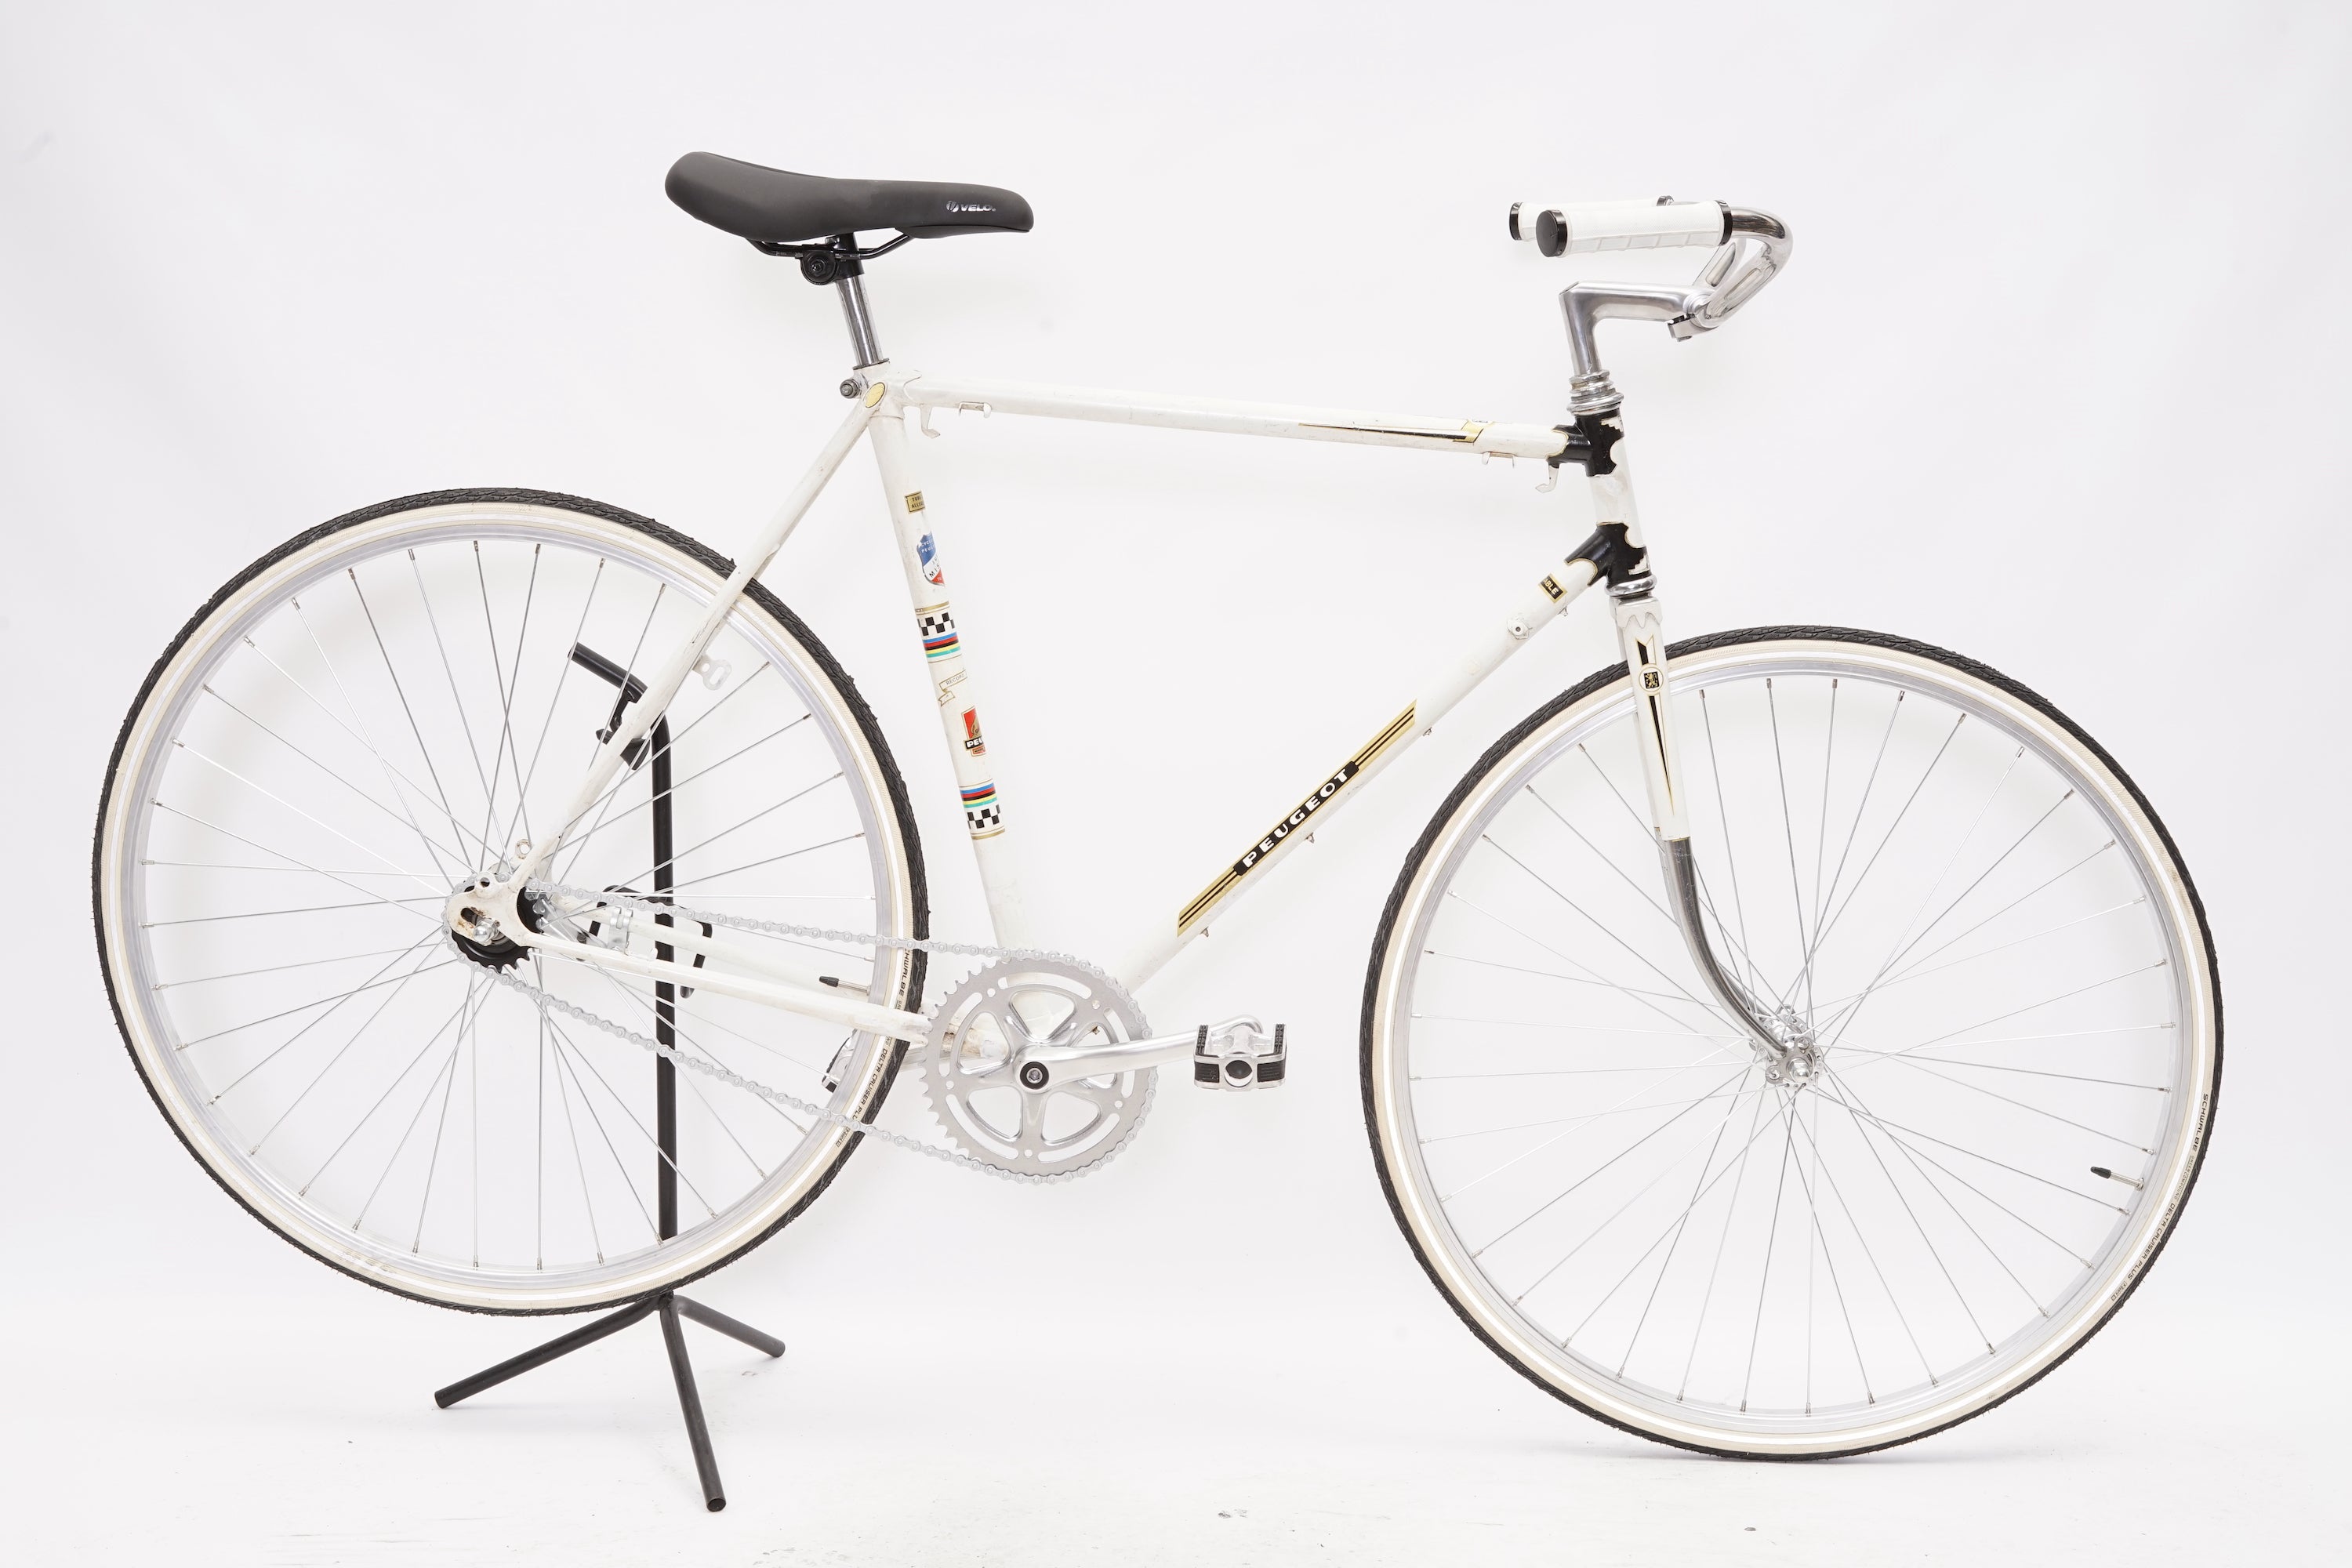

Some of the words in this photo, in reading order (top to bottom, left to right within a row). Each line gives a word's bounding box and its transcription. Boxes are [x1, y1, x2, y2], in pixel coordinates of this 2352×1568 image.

[1242, 768, 1348, 868] PEUGEOT
[875, 1047, 888, 1073] DELTA
[860, 1073, 878, 1105] CRUISER
[2192, 1093, 2209, 1152] SCHWALBE
[2161, 1203, 2176, 1228] DELTA
[2141, 1228, 2163, 1260] CRUISER
[2127, 1260, 2143, 1280] PLUS
